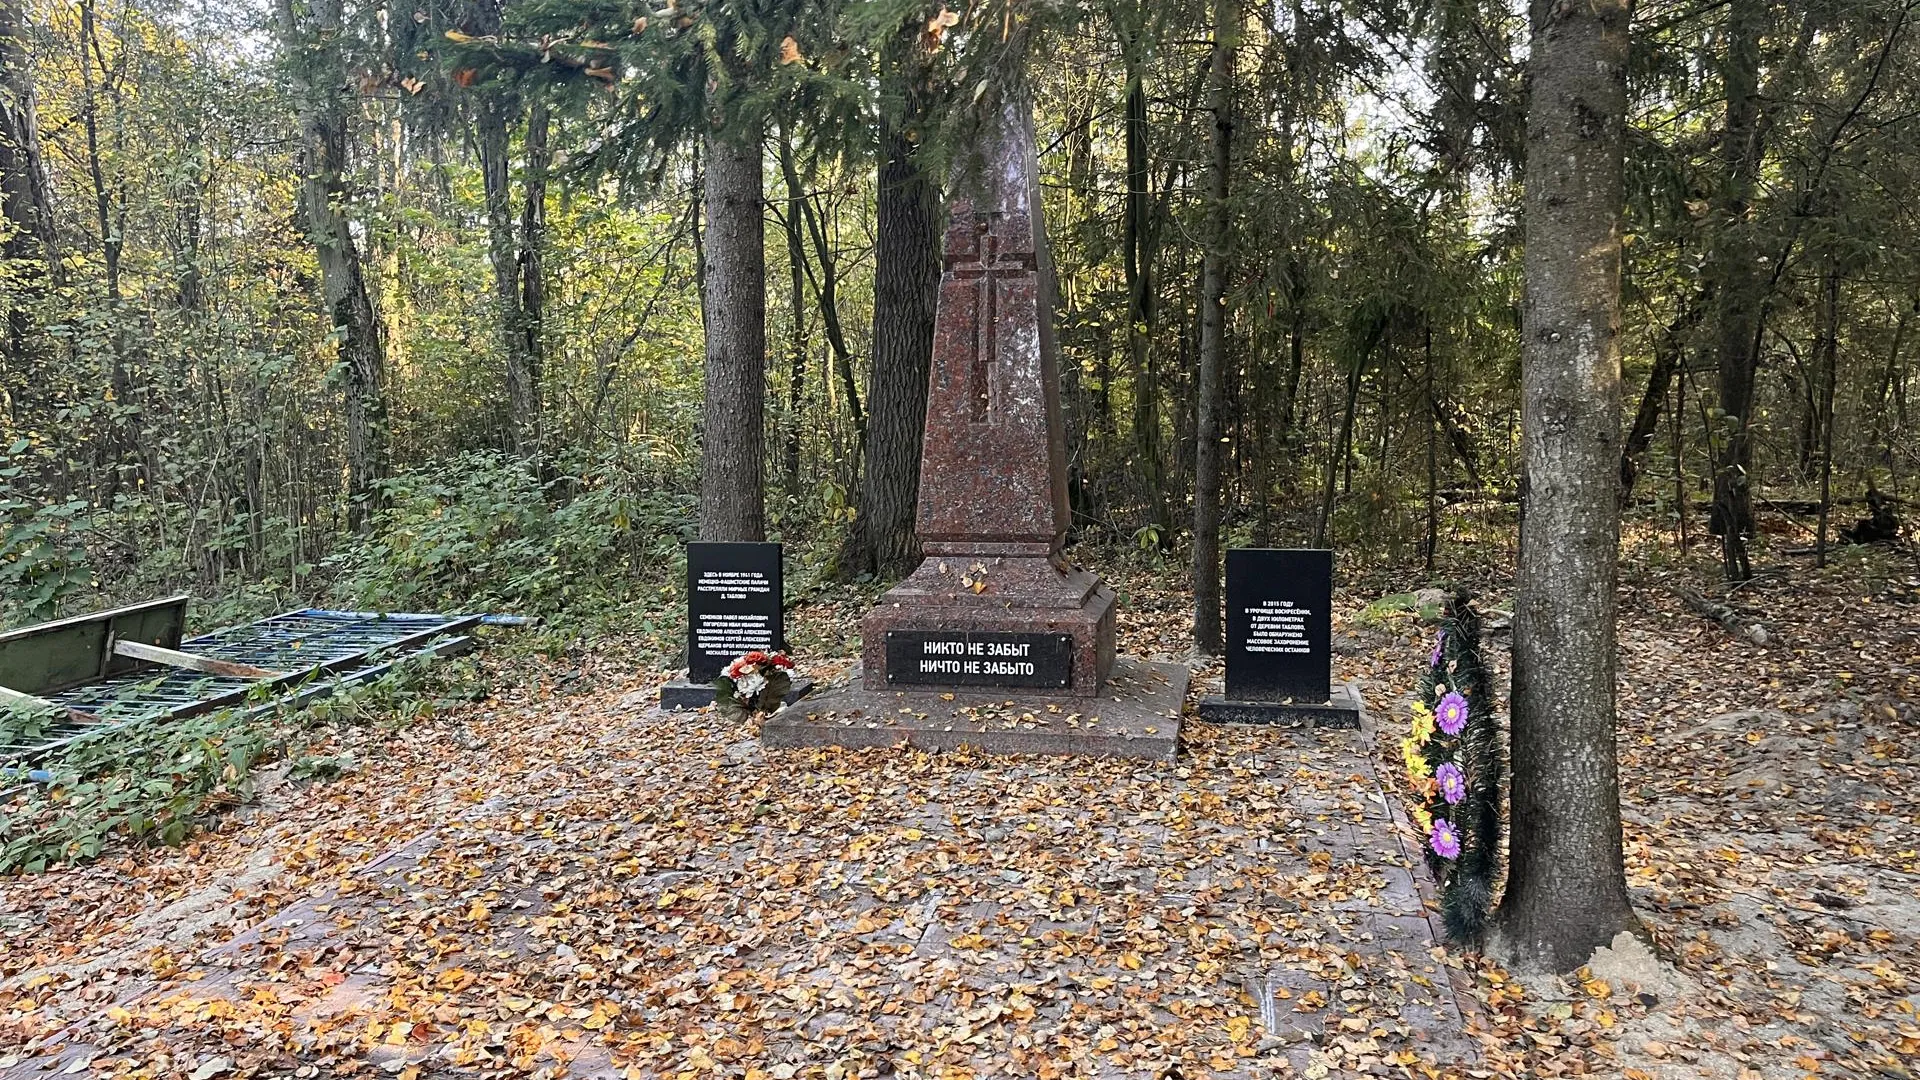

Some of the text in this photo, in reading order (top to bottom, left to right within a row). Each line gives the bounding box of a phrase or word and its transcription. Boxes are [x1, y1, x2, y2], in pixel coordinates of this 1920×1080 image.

[924, 642, 1030, 656] НИКТО НЕ ЗАБЫТ
[920, 660, 1034, 675] НИЧТО НЕ ЗАБЫТО
